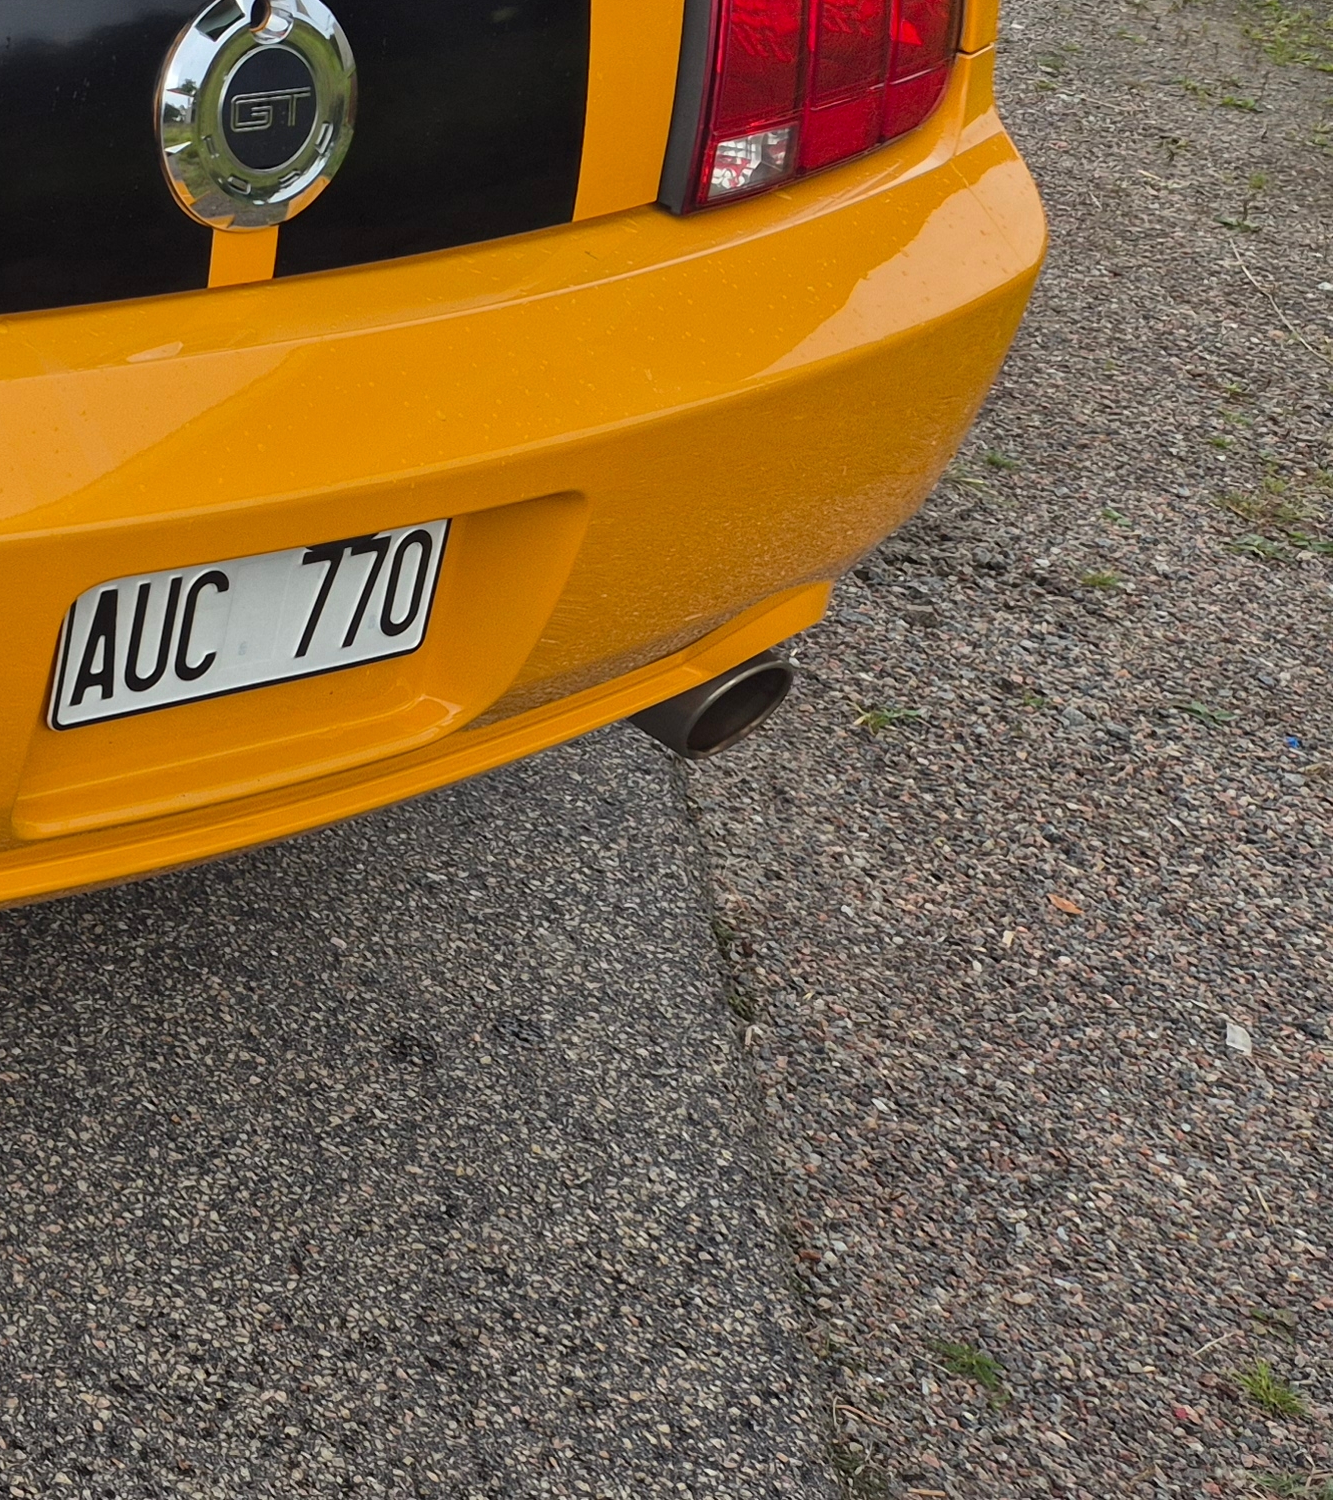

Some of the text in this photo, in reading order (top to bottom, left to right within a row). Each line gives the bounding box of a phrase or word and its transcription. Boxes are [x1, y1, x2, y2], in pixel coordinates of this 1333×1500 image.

[230, 86, 311, 132] GT
[69, 528, 433, 707] AUC 770
